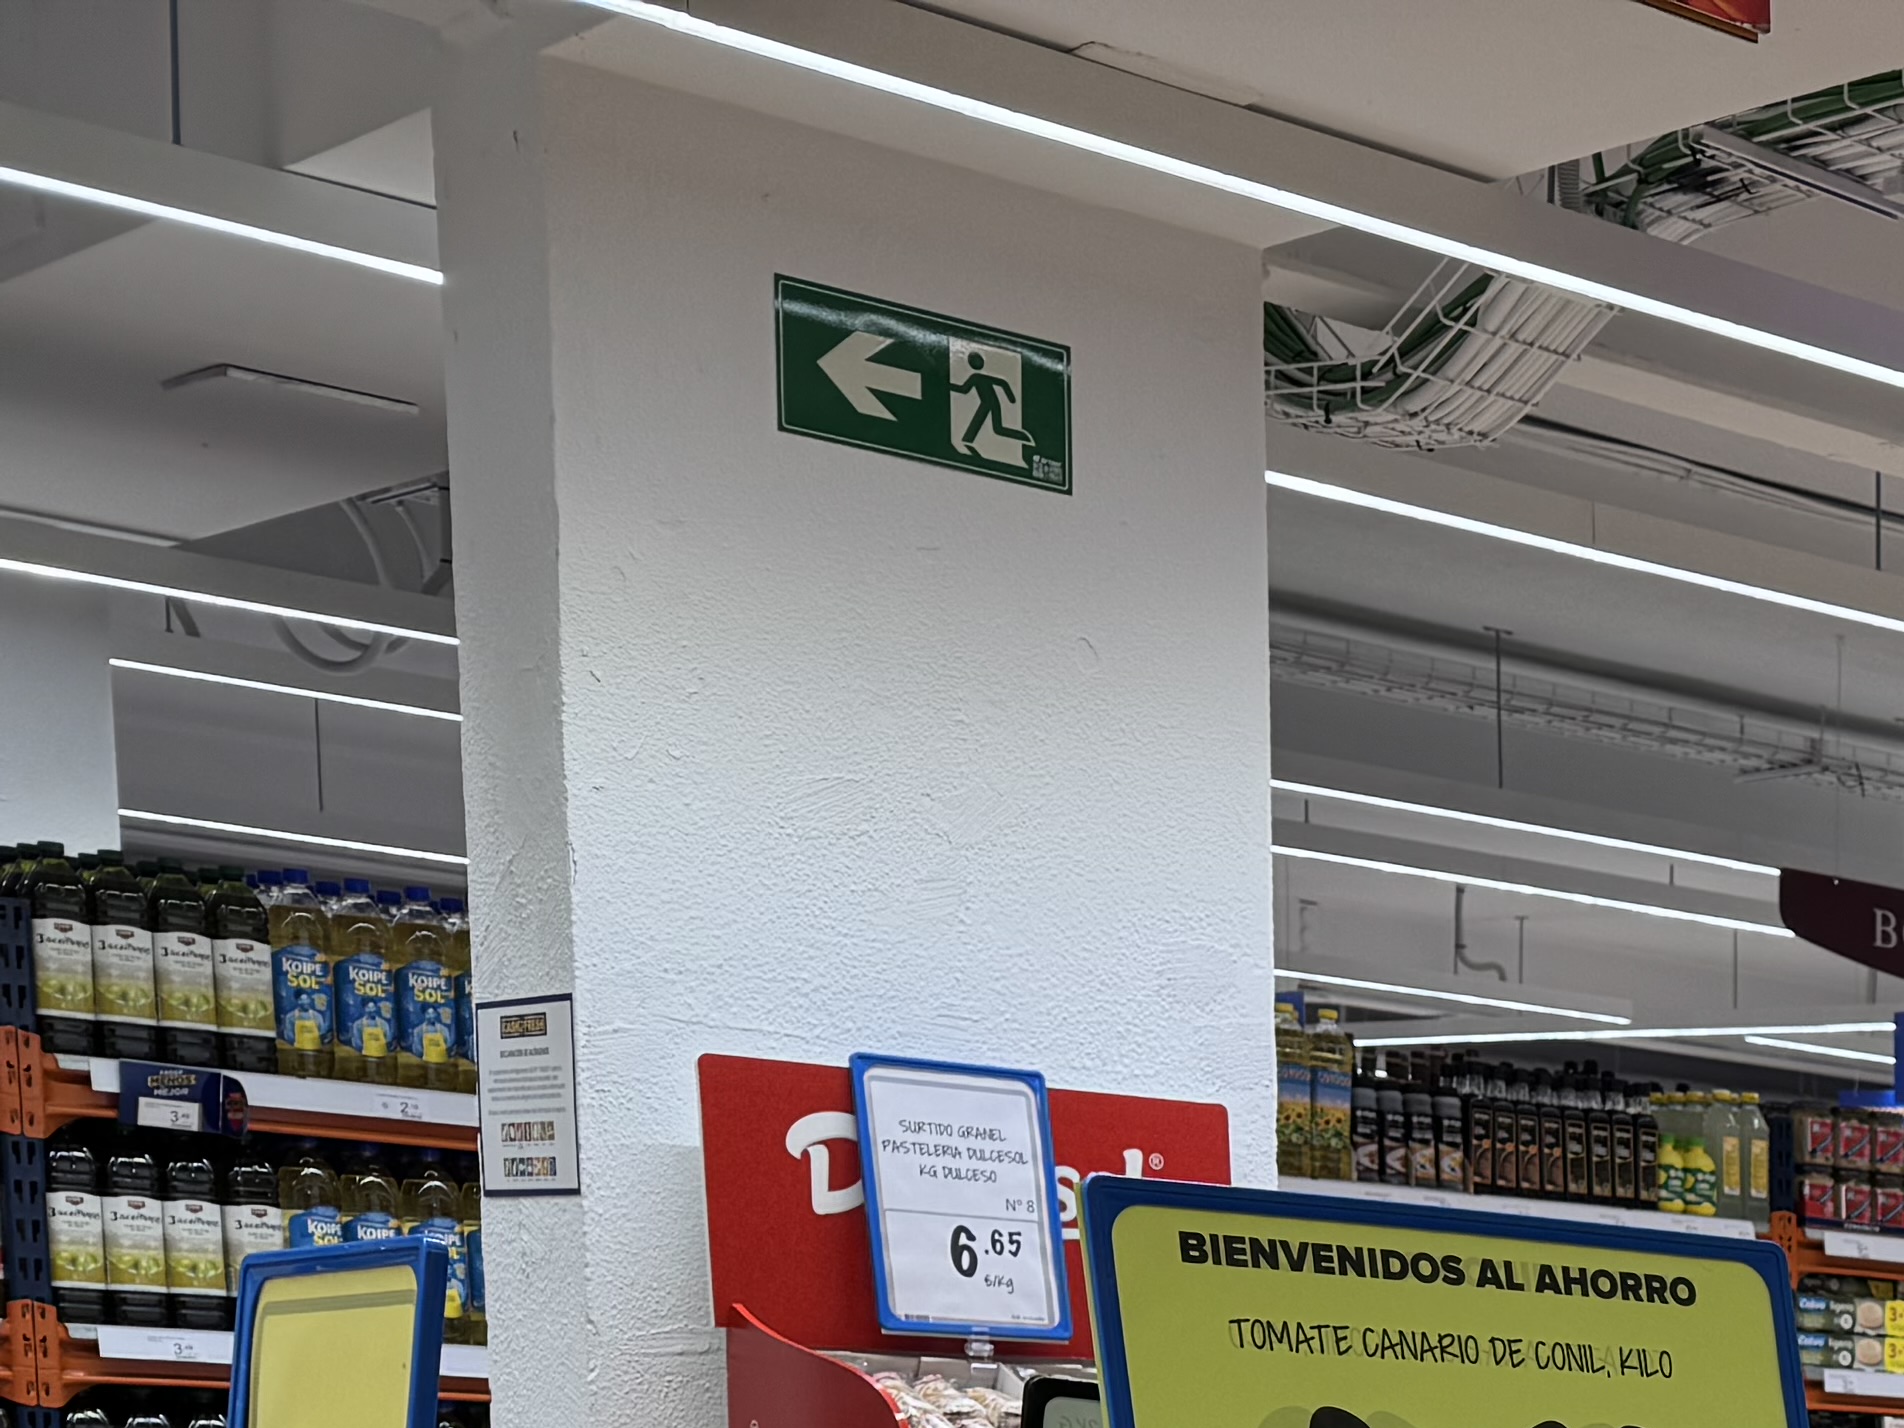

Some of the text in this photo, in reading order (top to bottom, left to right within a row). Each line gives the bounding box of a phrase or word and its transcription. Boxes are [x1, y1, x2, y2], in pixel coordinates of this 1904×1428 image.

[282, 958, 323, 974] KOIPE
[287, 972, 320, 989] SOL
[349, 967, 387, 984] KOIPE
[408, 973, 446, 990] KOIPE
[355, 980, 385, 996] SOL
[414, 988, 445, 1002] SOL
[899, 1120, 1006, 1142] SURTIDO GRANEL
[881, 1139, 1028, 1165] PASTELERIA DULCESOL
[919, 1164, 997, 1183] KG DULCESO
[1026, 1201, 1035, 1213] 8
[1179, 1230, 1697, 1307] BIENVENIDOS AL AHORRO
[1229, 1318, 1674, 1379] TOMATE CANARIO DE CONIL, KILO
